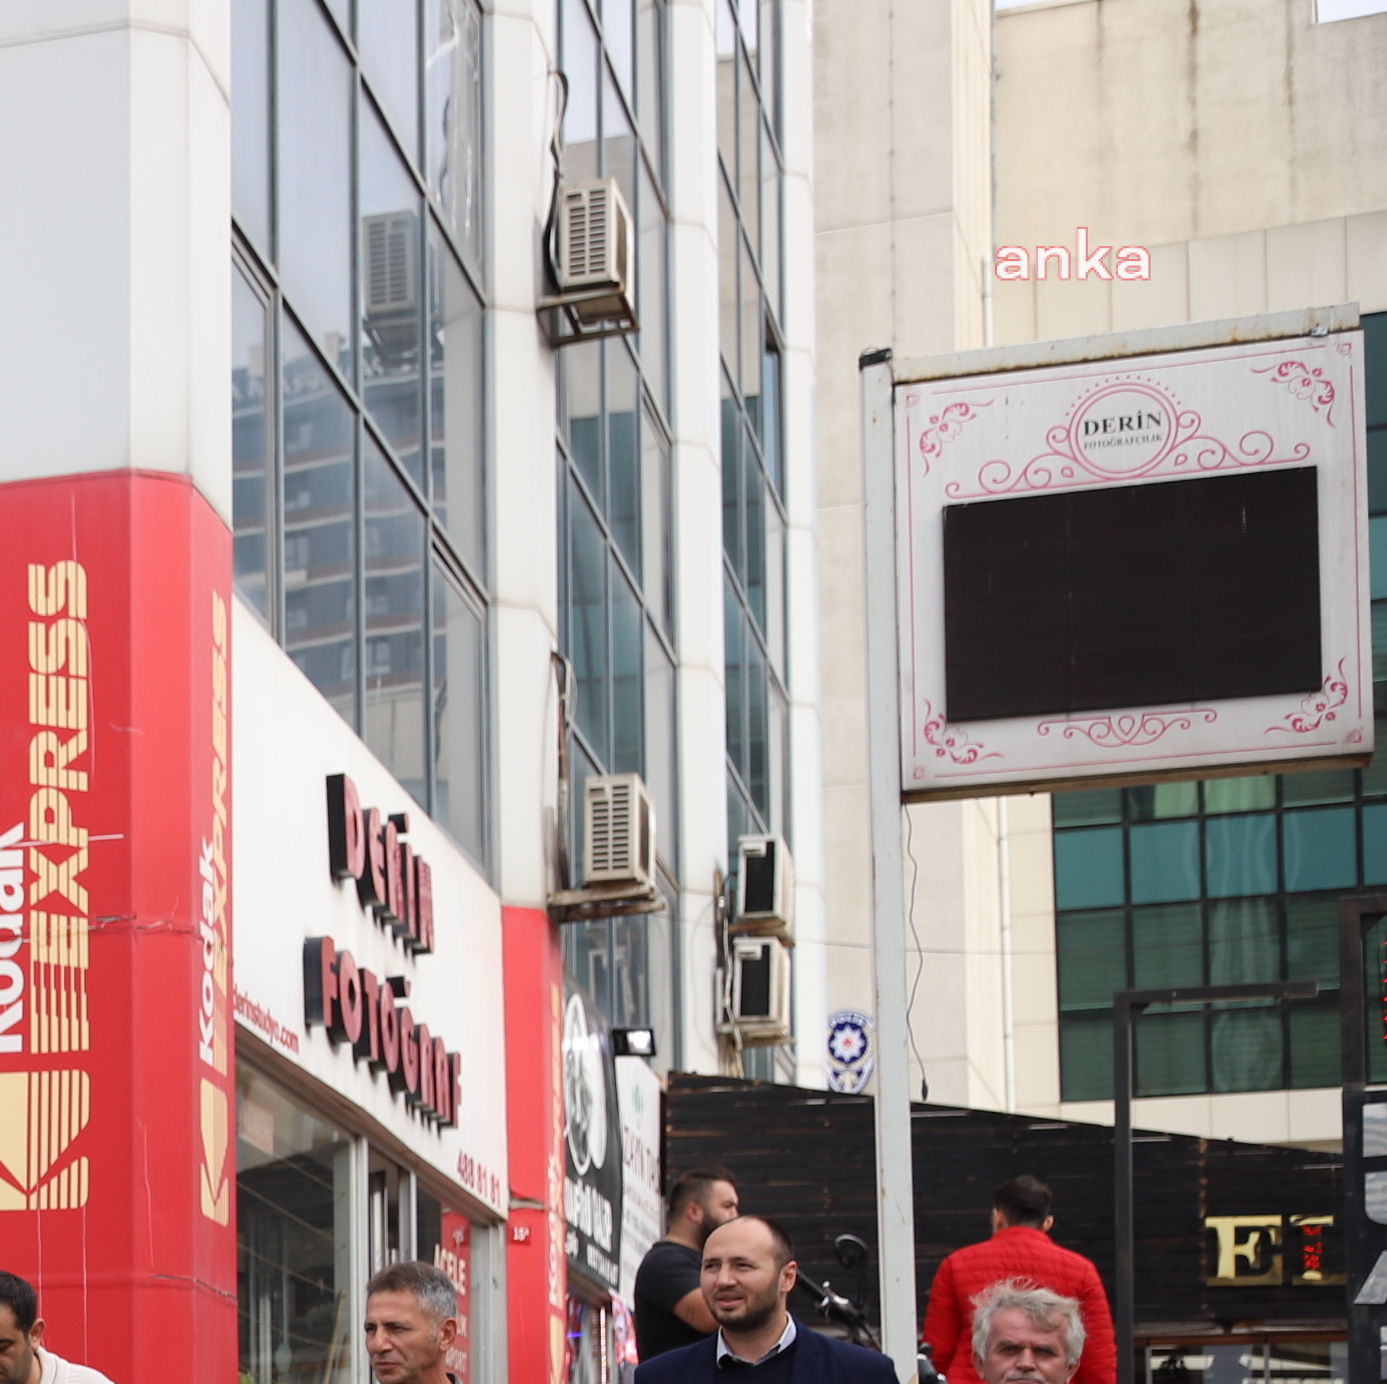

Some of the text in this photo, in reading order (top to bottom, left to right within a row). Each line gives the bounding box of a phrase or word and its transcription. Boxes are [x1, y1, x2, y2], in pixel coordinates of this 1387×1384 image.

[1083, 410, 1162, 436] DERİN
[28, 560, 90, 1054] EXPRESS
[199, 838, 214, 1064] Kodak
